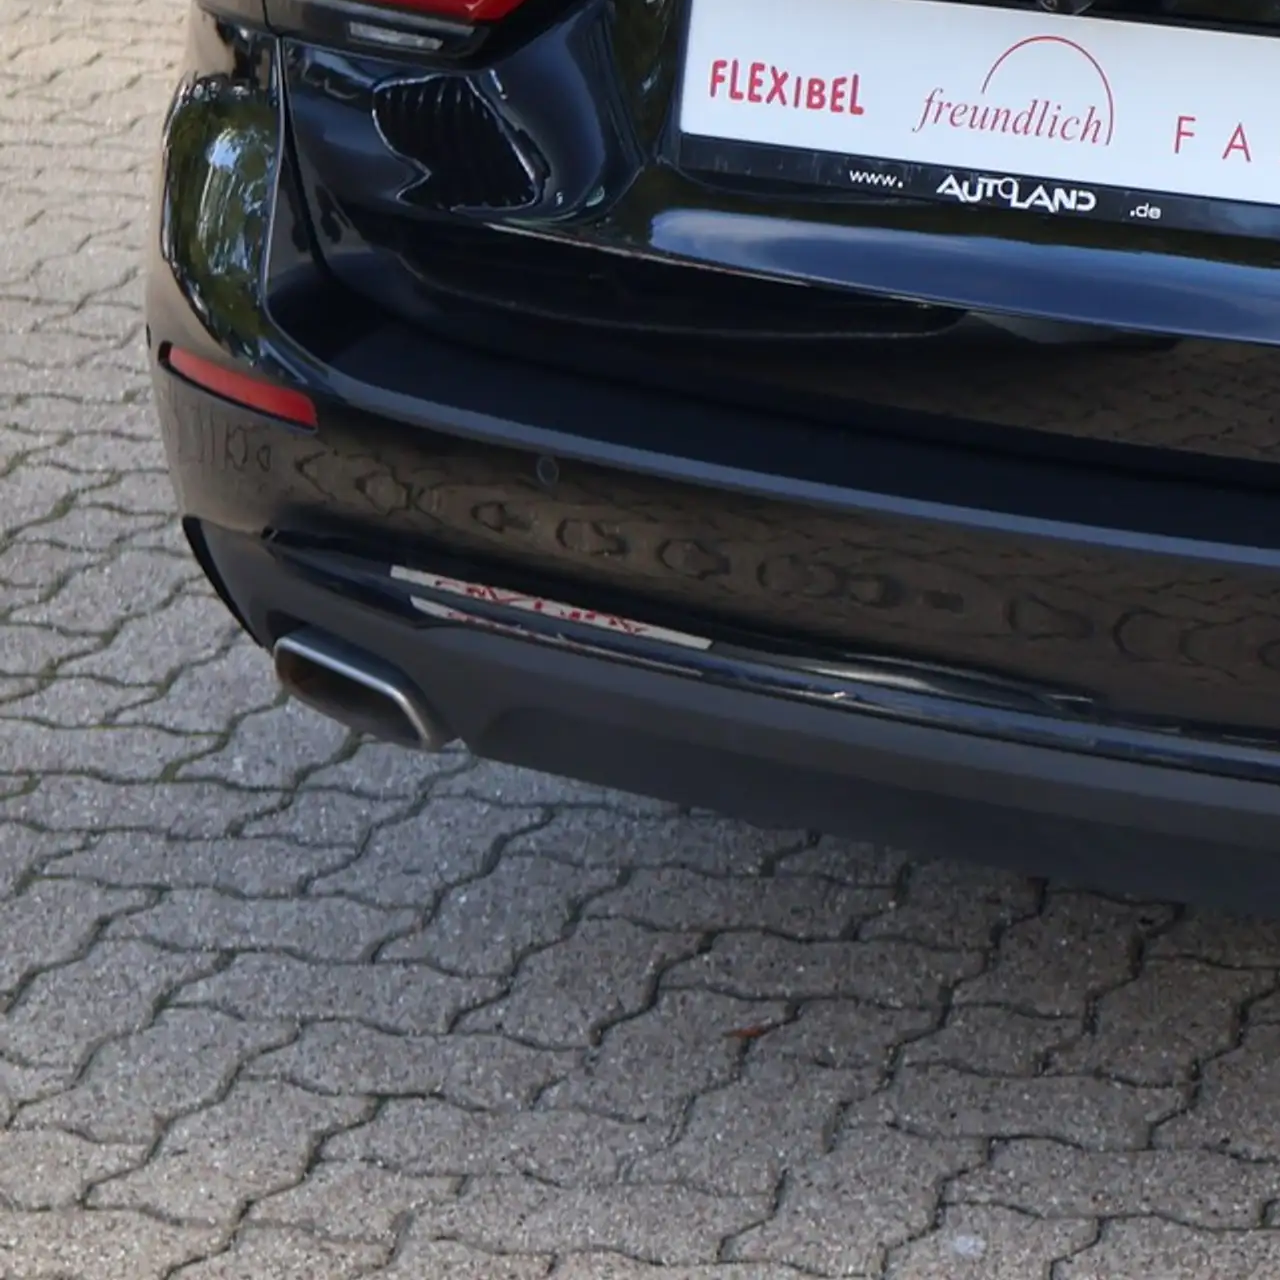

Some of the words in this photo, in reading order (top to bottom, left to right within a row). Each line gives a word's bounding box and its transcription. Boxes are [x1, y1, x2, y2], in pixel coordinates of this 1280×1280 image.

[708, 58, 866, 117] FLEXIBEL
[910, 86, 1103, 146] freundlich
[848, 170, 905, 189] www.
[935, 173, 1097, 214] AUTOLAND
[1129, 202, 1162, 220] .de
